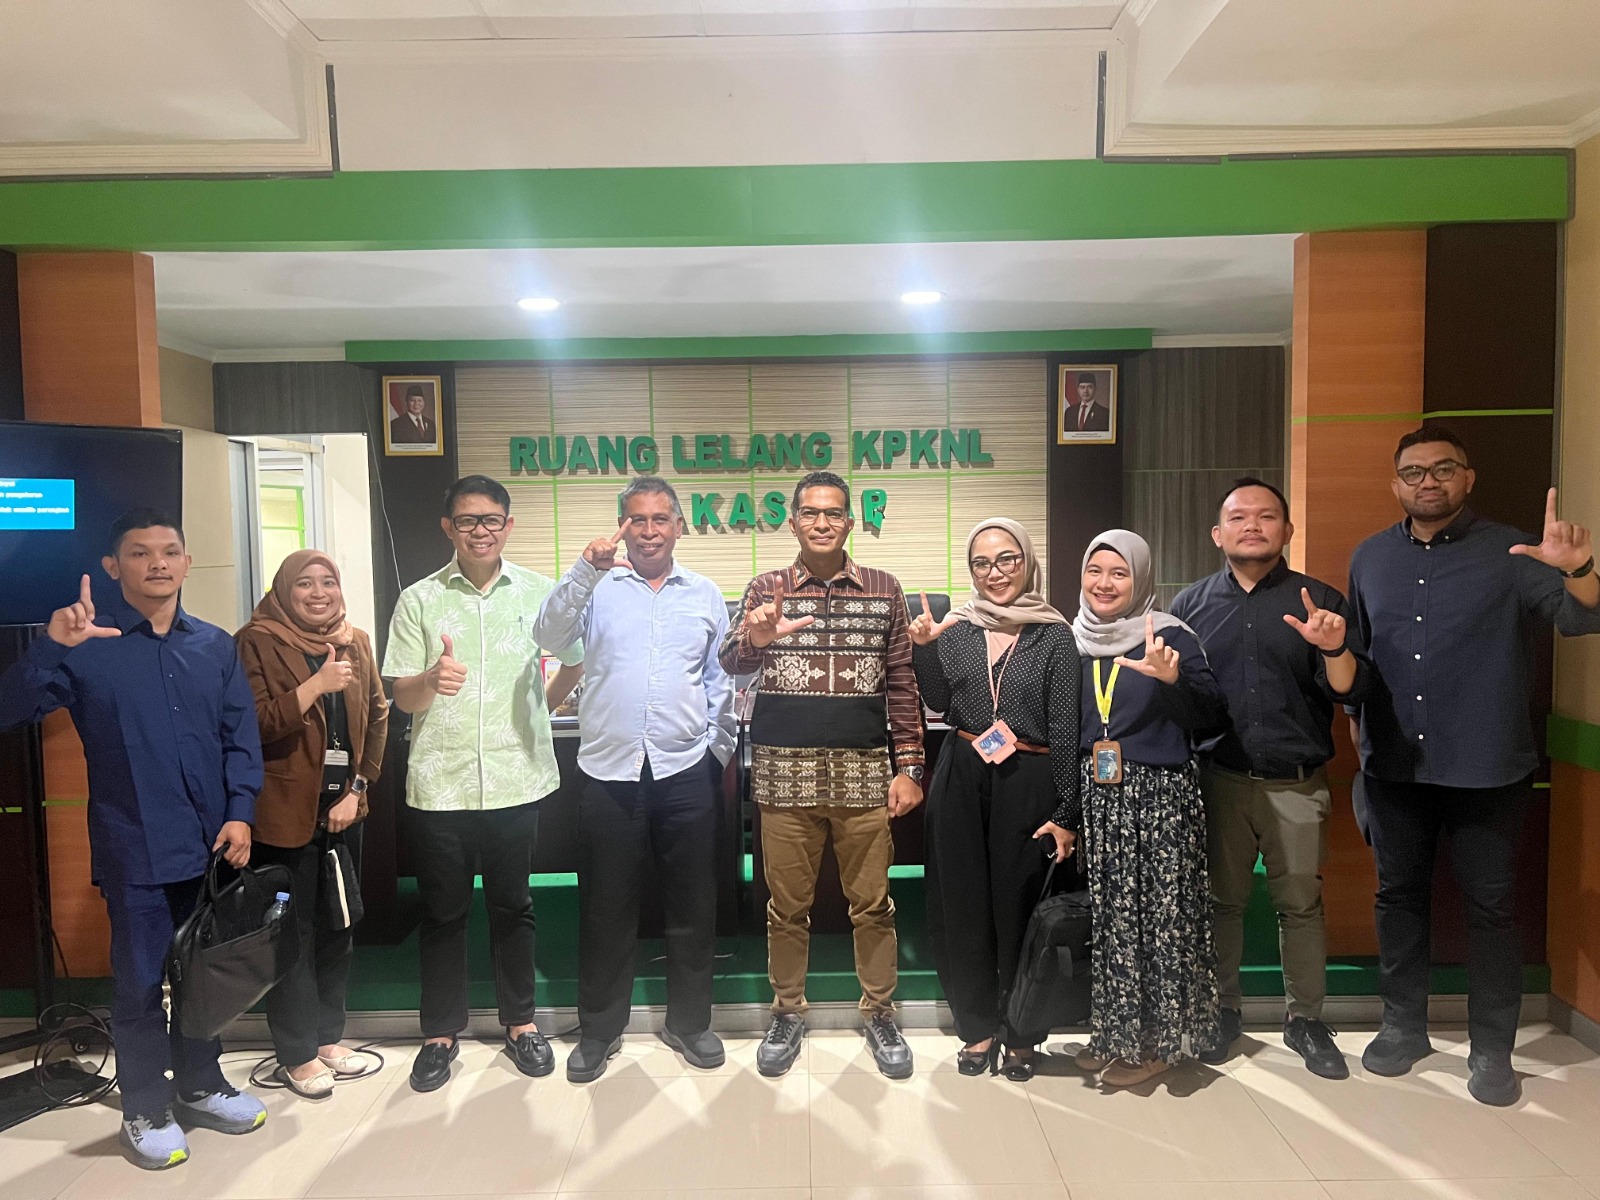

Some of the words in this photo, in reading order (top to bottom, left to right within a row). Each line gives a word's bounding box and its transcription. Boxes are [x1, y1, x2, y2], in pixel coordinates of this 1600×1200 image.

[509, 435, 658, 472] RUANG
[671, 431, 833, 470] LELANG
[852, 428, 993, 466] KPKNL
[617, 489, 888, 530] KASR
